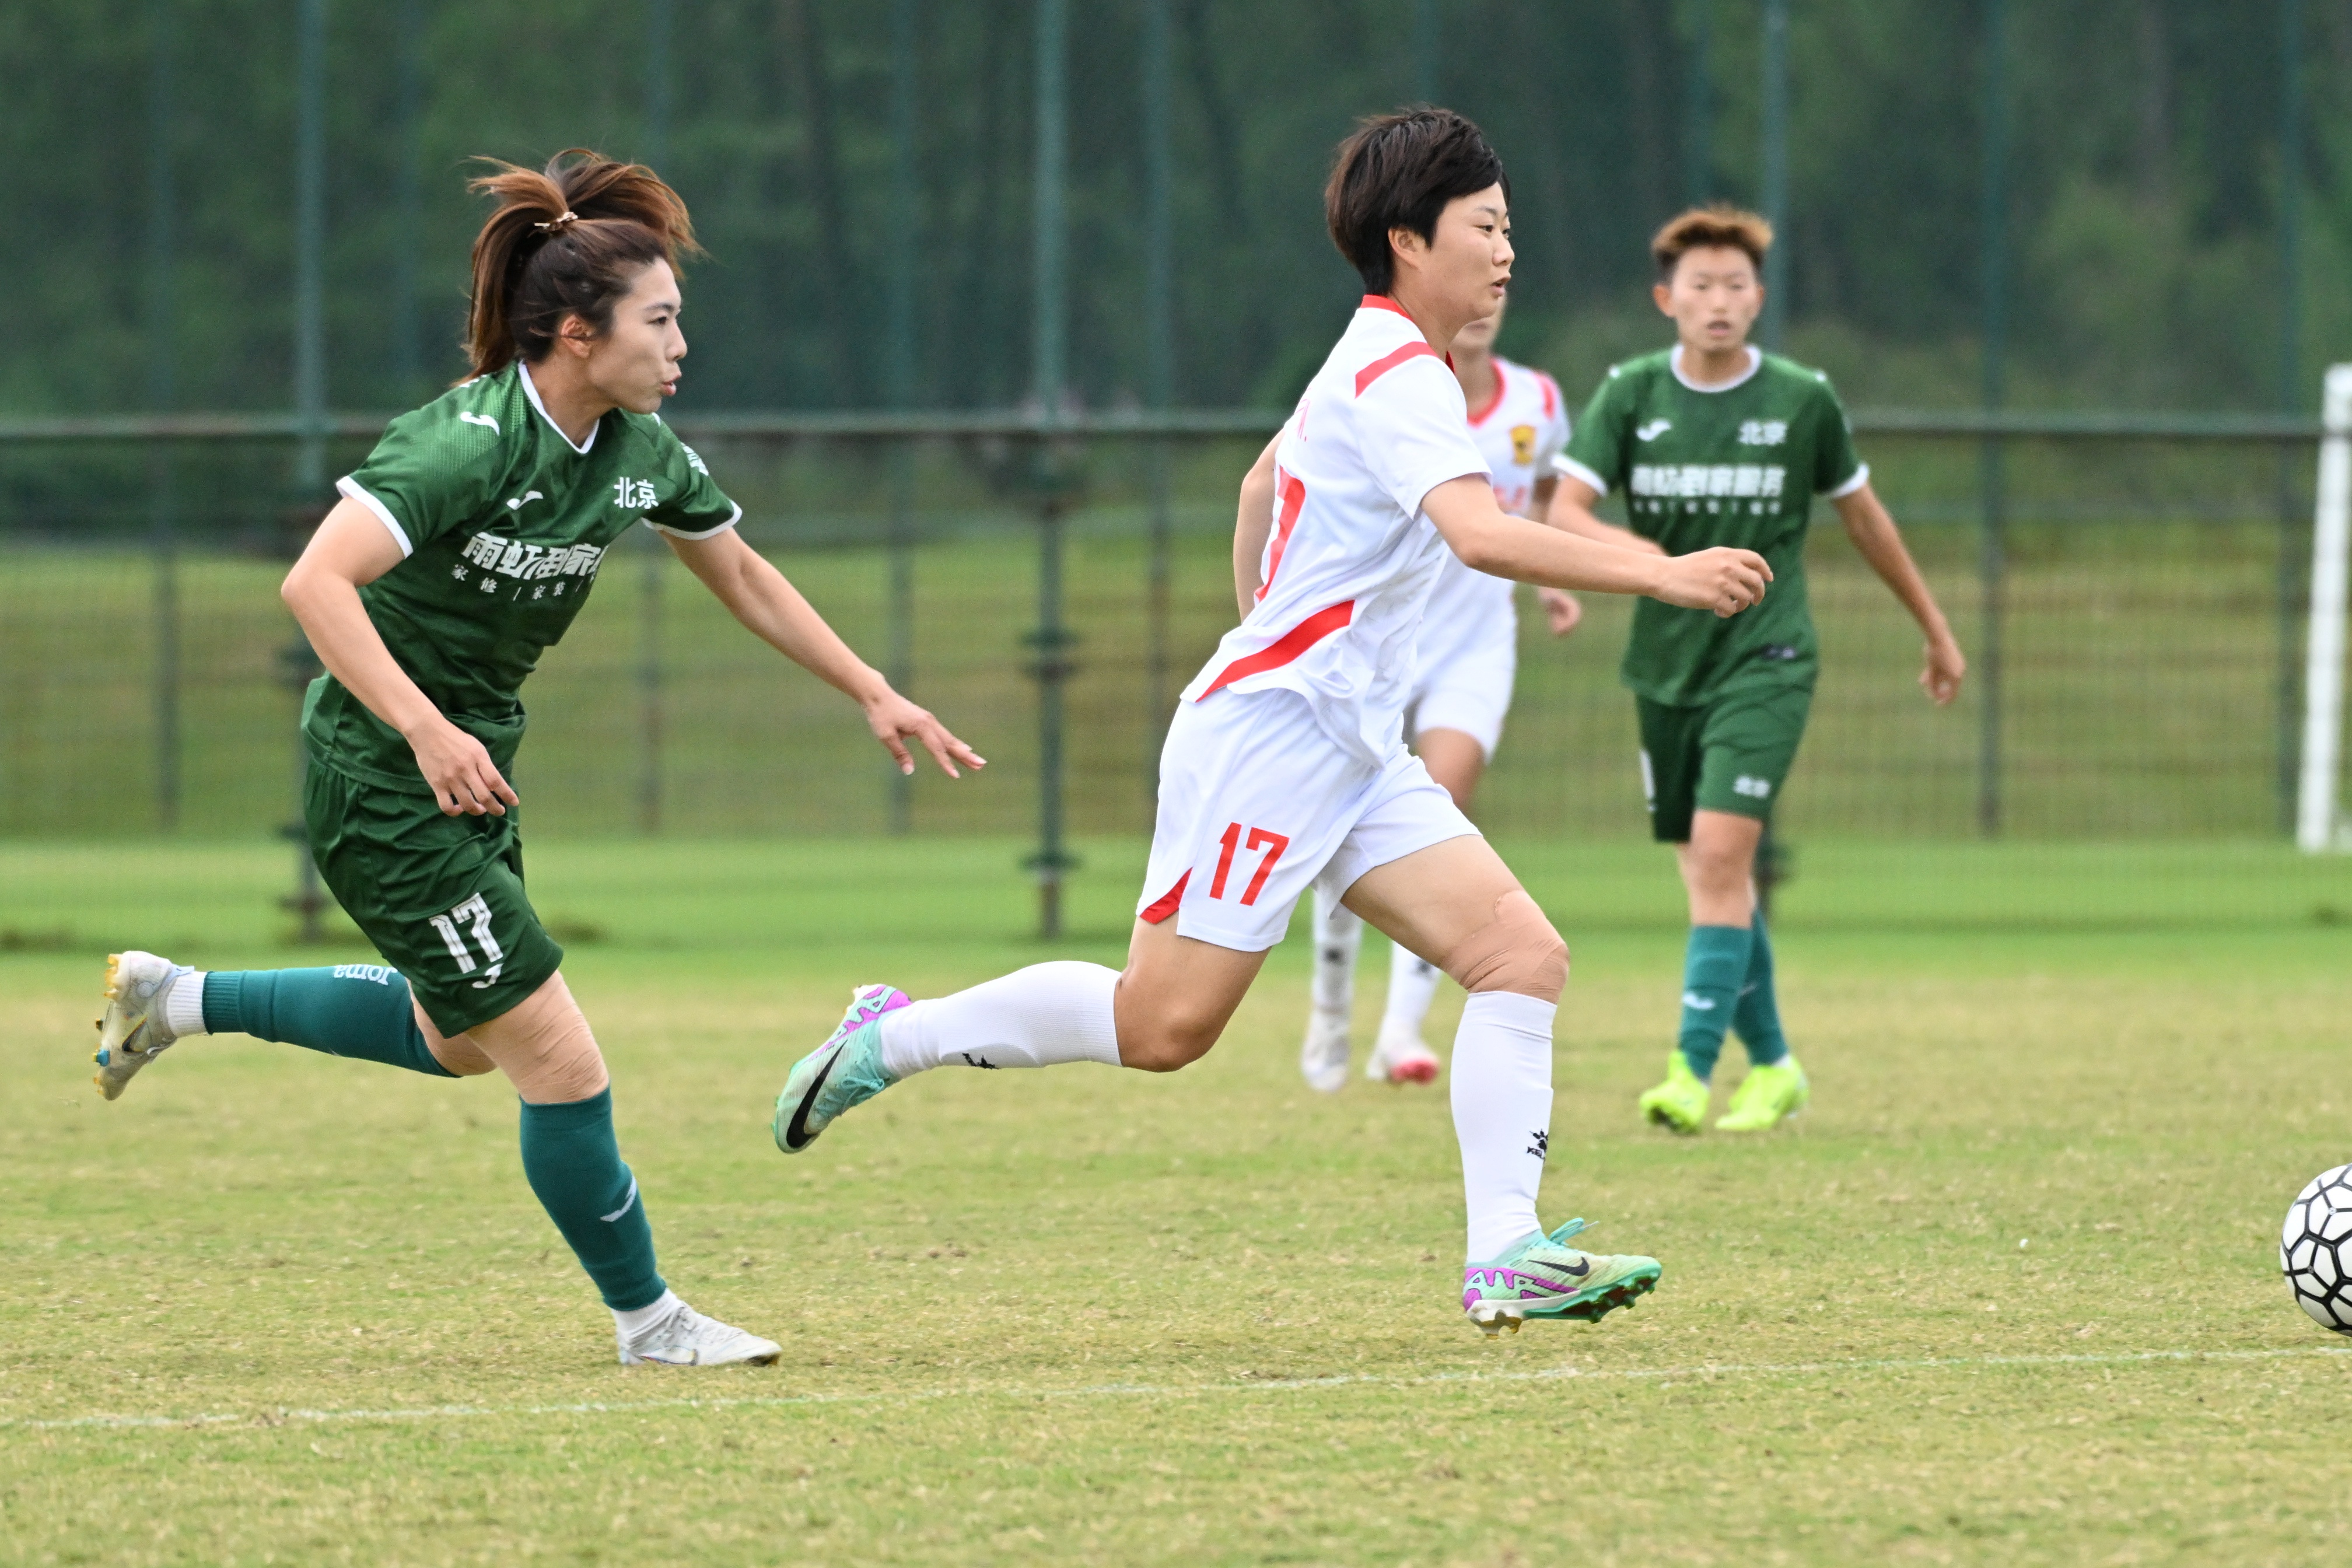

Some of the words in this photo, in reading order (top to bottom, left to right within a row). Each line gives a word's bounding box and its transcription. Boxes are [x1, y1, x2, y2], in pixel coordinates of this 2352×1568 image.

[614, 477, 659, 510] 北京
[461, 531, 610, 580] 雨虹到家
[1209, 822, 1290, 907] 17
[429, 892, 503, 974] 17
[334, 964, 398, 986] Joma
